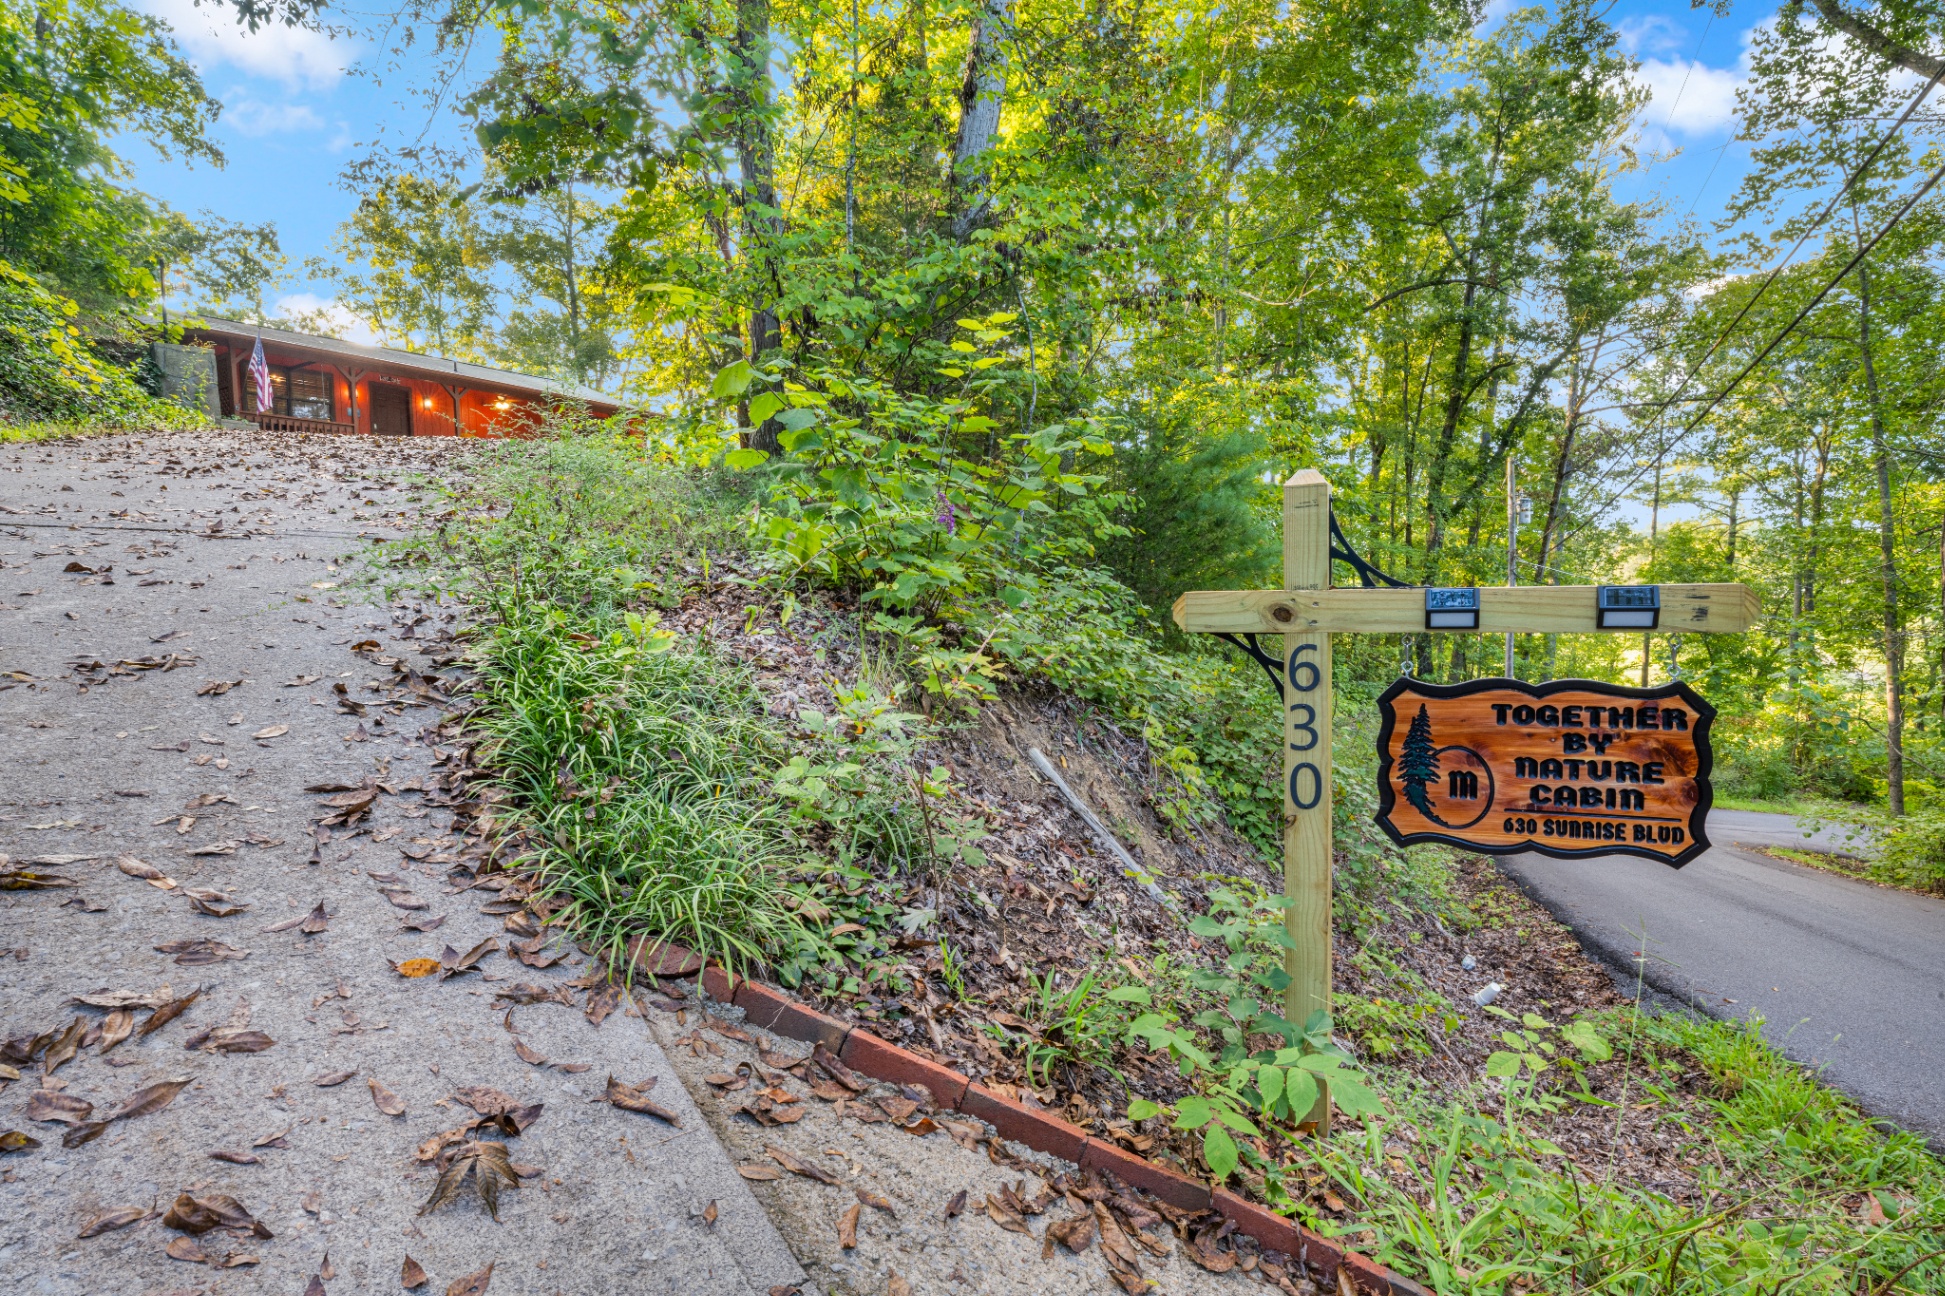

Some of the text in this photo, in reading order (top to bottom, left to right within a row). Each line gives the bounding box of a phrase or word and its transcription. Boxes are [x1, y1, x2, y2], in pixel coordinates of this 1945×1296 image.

[1289, 644, 1322, 809] 630
[1491, 703, 1689, 731] TOGETHER
[1562, 732, 1613, 756] BY
[1514, 757, 1665, 785] NATURE
[1529, 784, 1645, 811] CABIN
[1503, 817, 1537, 835] 630
[1543, 819, 1627, 842] SUNRISE
